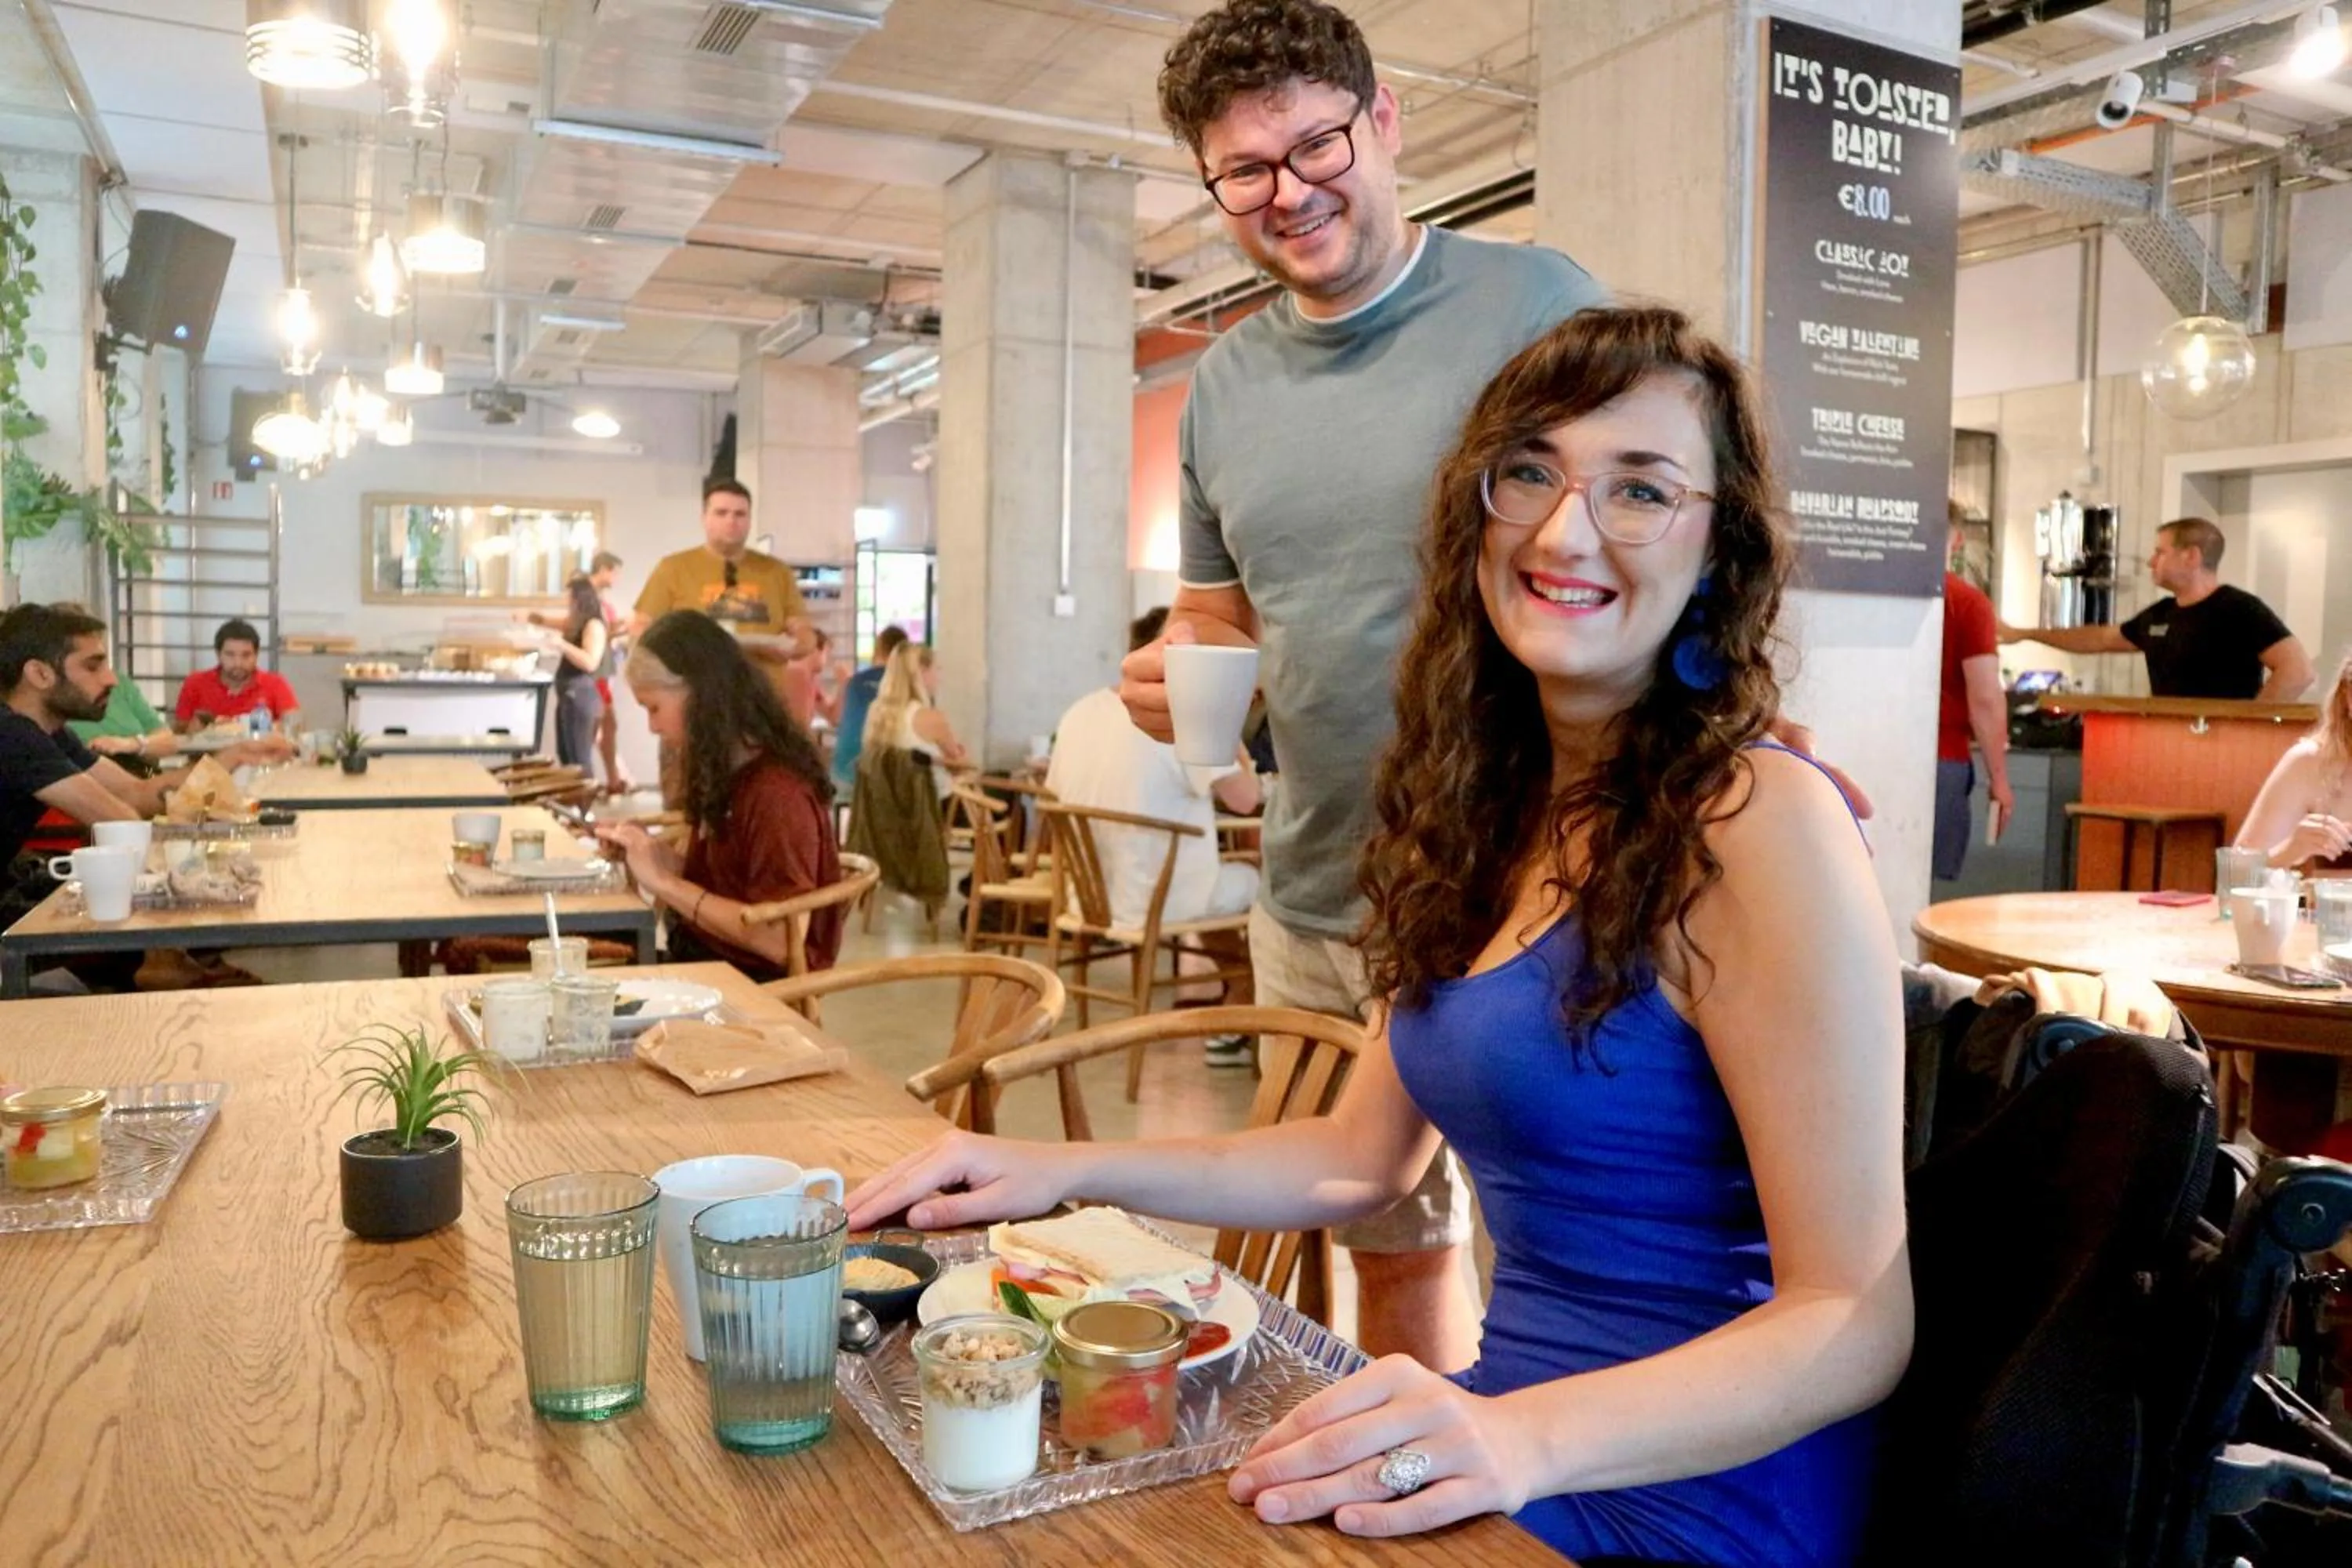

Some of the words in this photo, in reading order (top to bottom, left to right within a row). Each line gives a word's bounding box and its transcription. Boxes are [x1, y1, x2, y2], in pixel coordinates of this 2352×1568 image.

[1775, 52, 1823, 103] IT'S
[1831, 119, 1902, 175] BABY!
[1838, 183, 1891, 220] €8.00
[1815, 239, 1876, 272] CLASSIC
[1799, 321, 1848, 350] VEGAN
